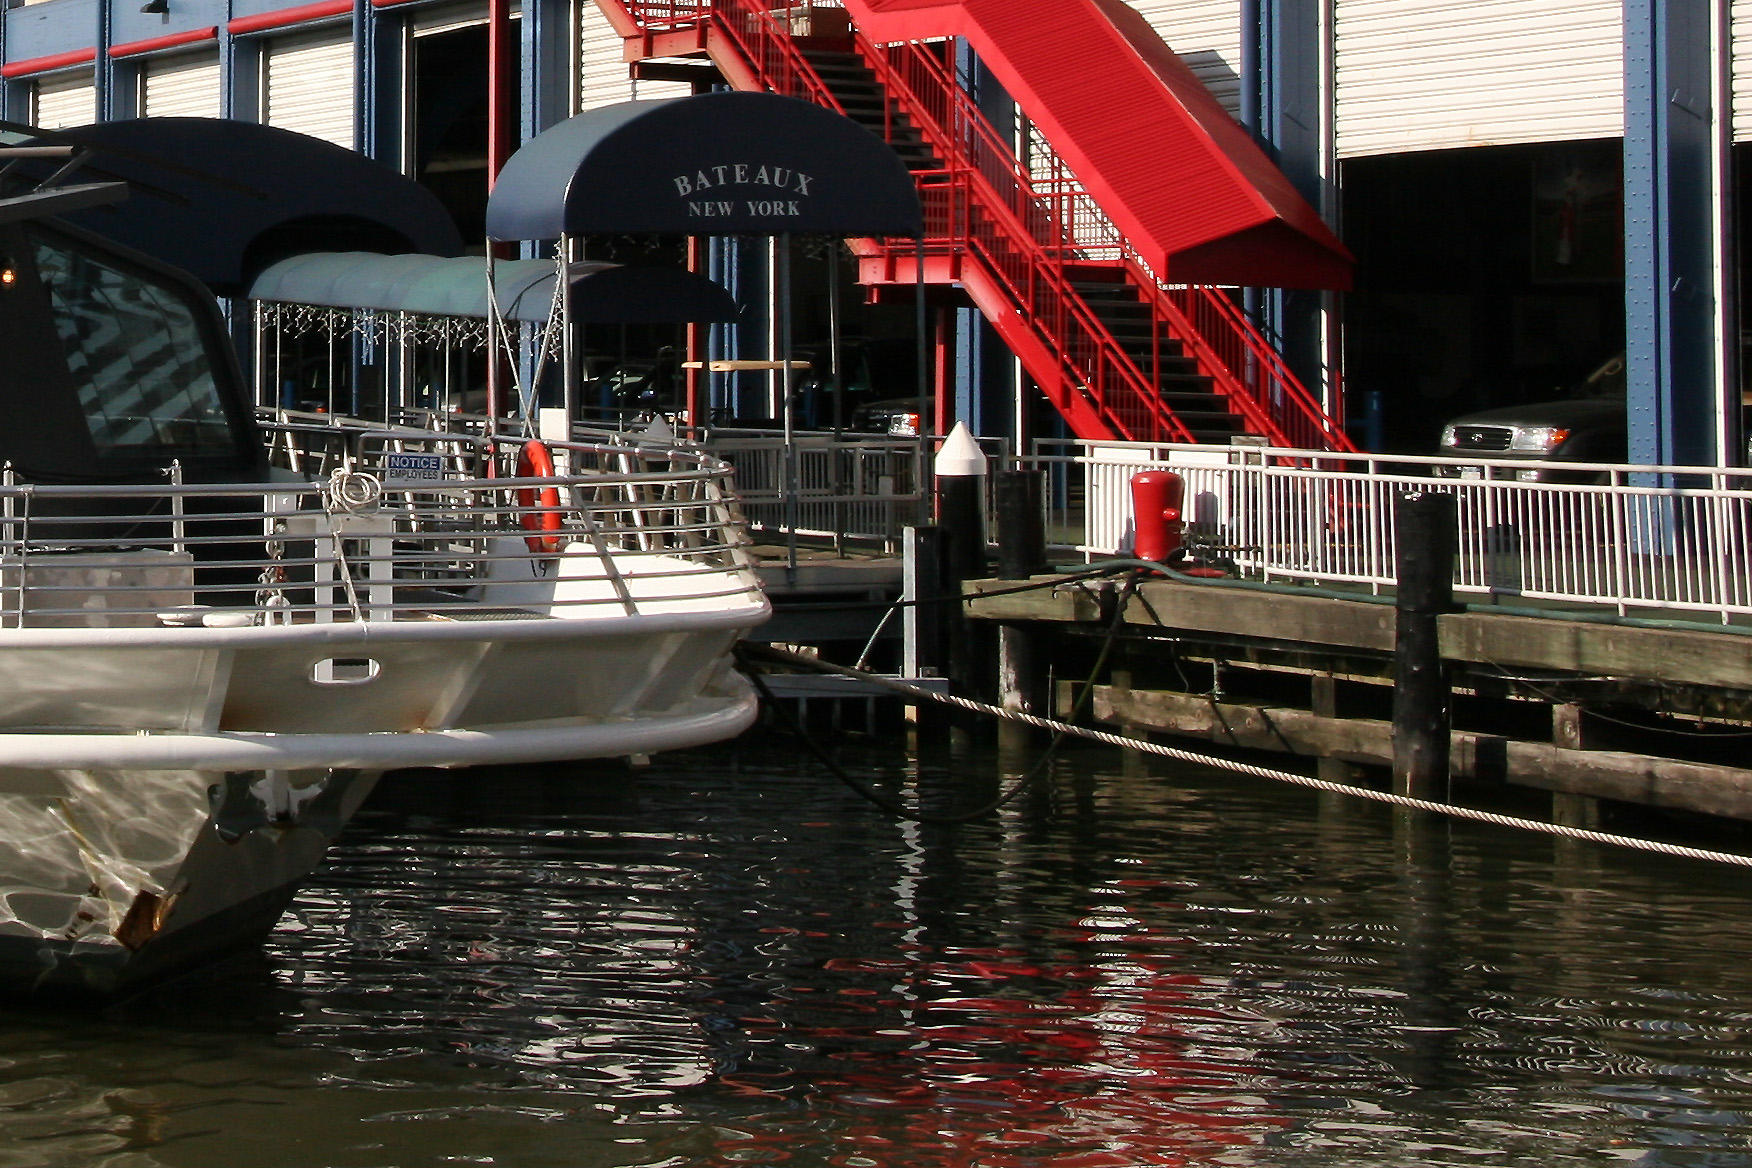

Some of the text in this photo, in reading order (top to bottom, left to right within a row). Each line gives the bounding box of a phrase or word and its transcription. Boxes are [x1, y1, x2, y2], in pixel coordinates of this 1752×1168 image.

[673, 163, 815, 196] BATEAUX
[688, 200, 800, 217] NEW YORK
[390, 456, 438, 469] NOTICE
[389, 468, 438, 481] EMPLOYEES
